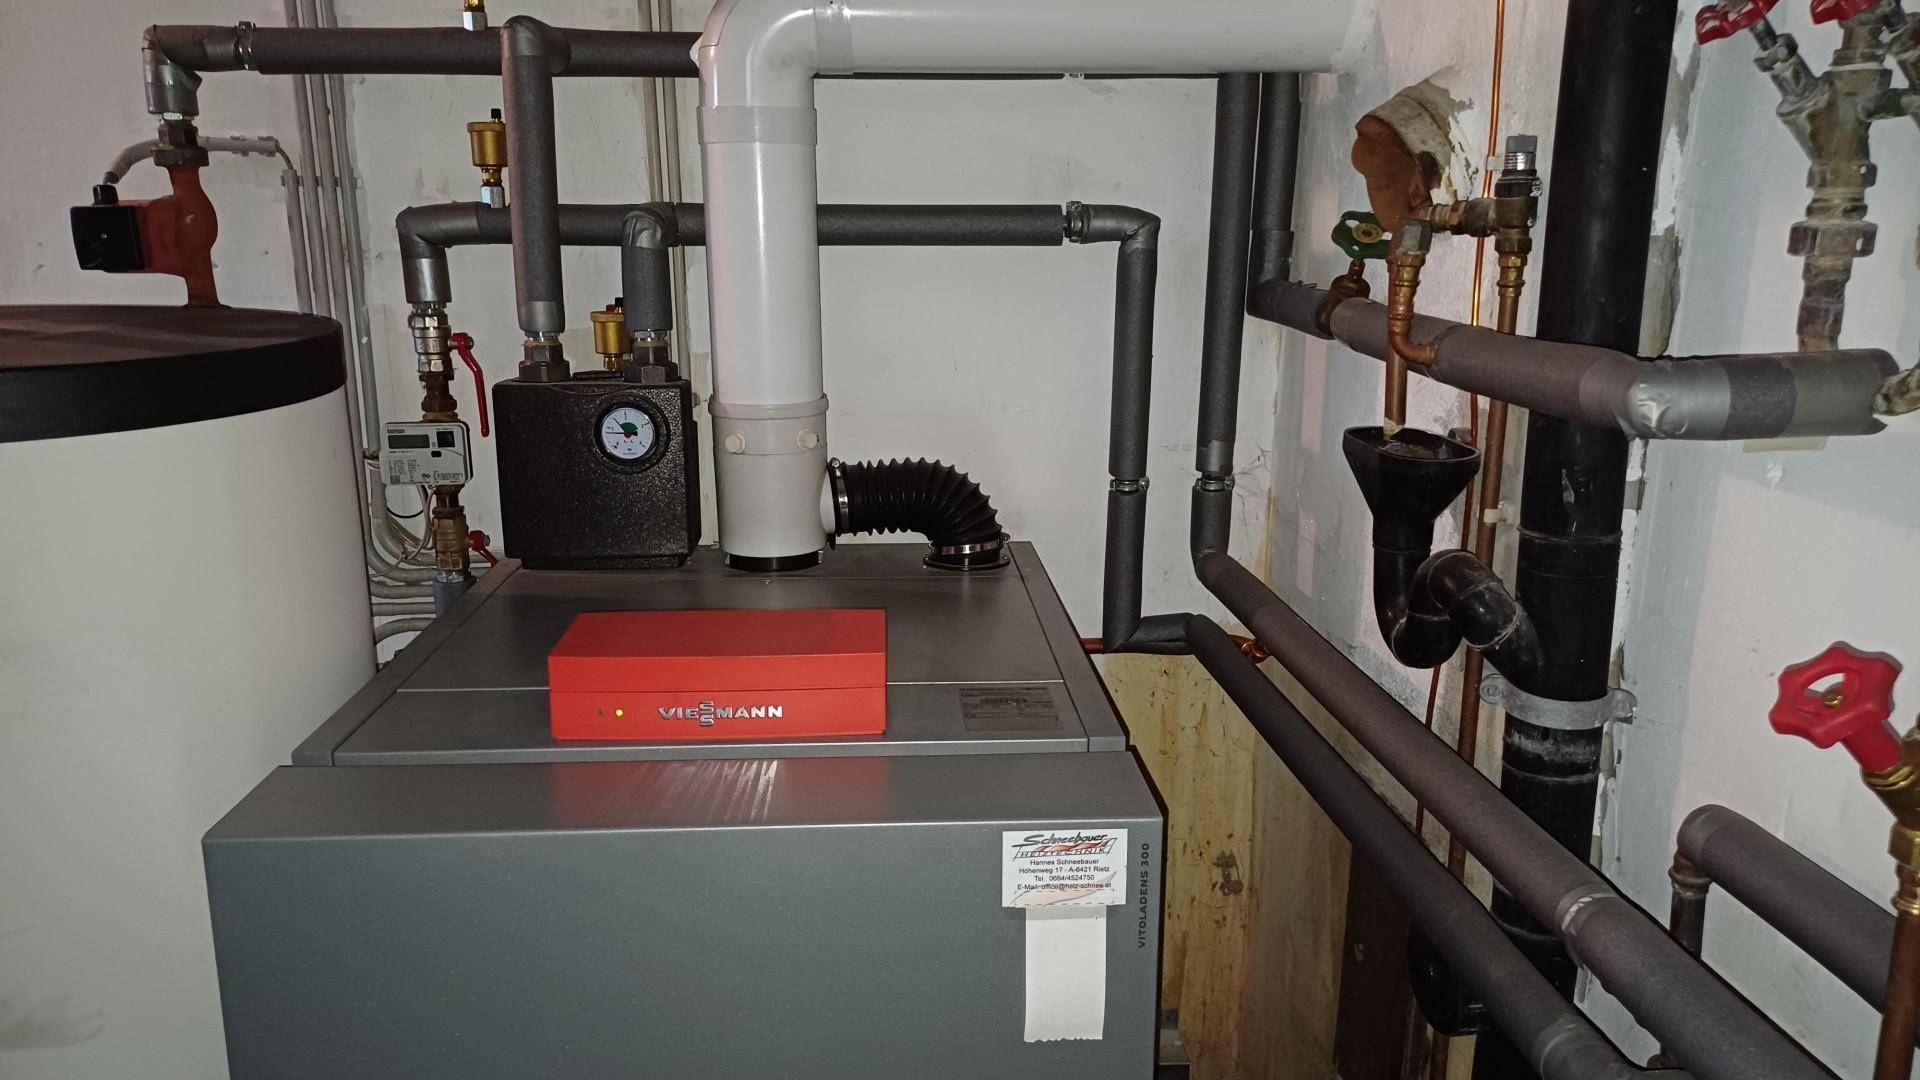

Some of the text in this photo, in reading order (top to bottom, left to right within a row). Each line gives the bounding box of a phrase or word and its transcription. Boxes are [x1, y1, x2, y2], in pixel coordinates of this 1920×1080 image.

[658, 700, 783, 726] VIESSMANN
[1011, 832, 1108, 848] Schneebauer
[1019, 867, 1053, 875] Höhenweg
[1138, 843, 1150, 949] VITOLADENS 300
